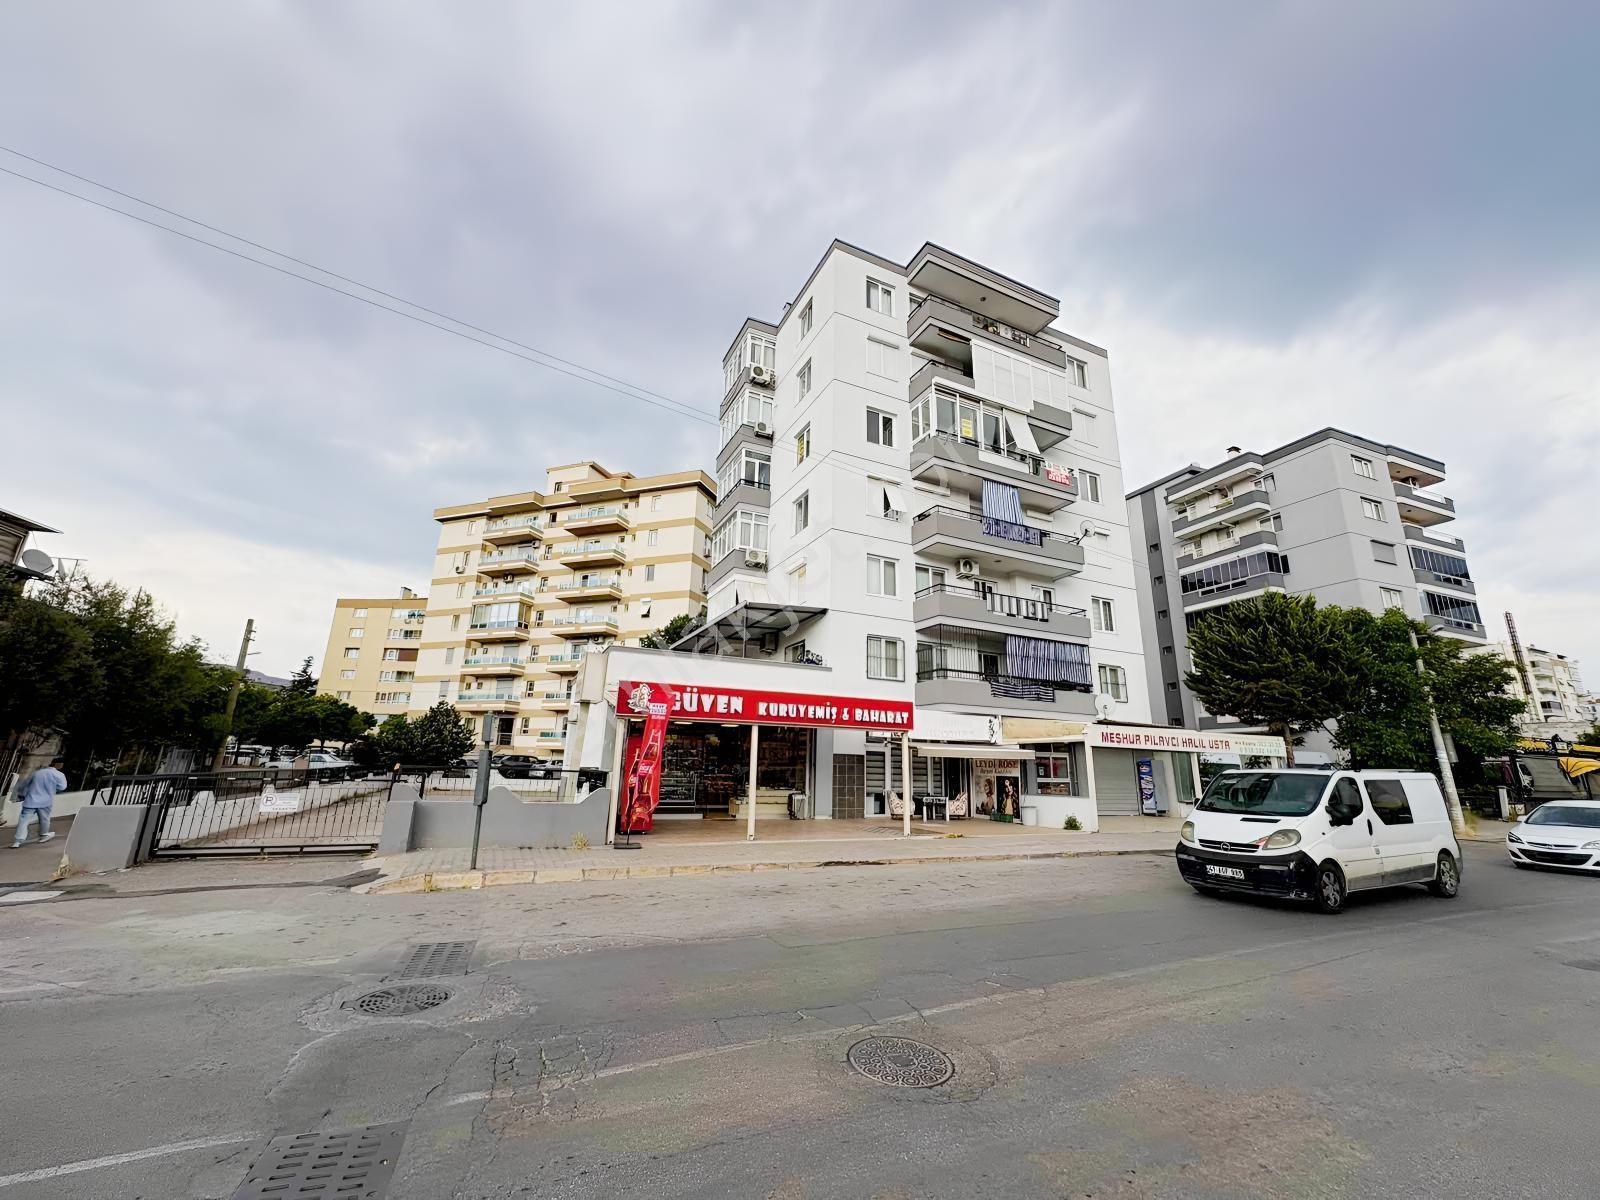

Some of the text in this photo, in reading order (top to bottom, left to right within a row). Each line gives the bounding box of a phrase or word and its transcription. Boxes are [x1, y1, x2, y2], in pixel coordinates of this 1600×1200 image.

[758, 702, 837, 723] KURUYEMİŞ
[842, 708, 849, 720] &
[855, 708, 909, 724] BAHARAT
[1208, 739, 1230, 750] USTA
[998, 759, 1019, 769] ROSE
